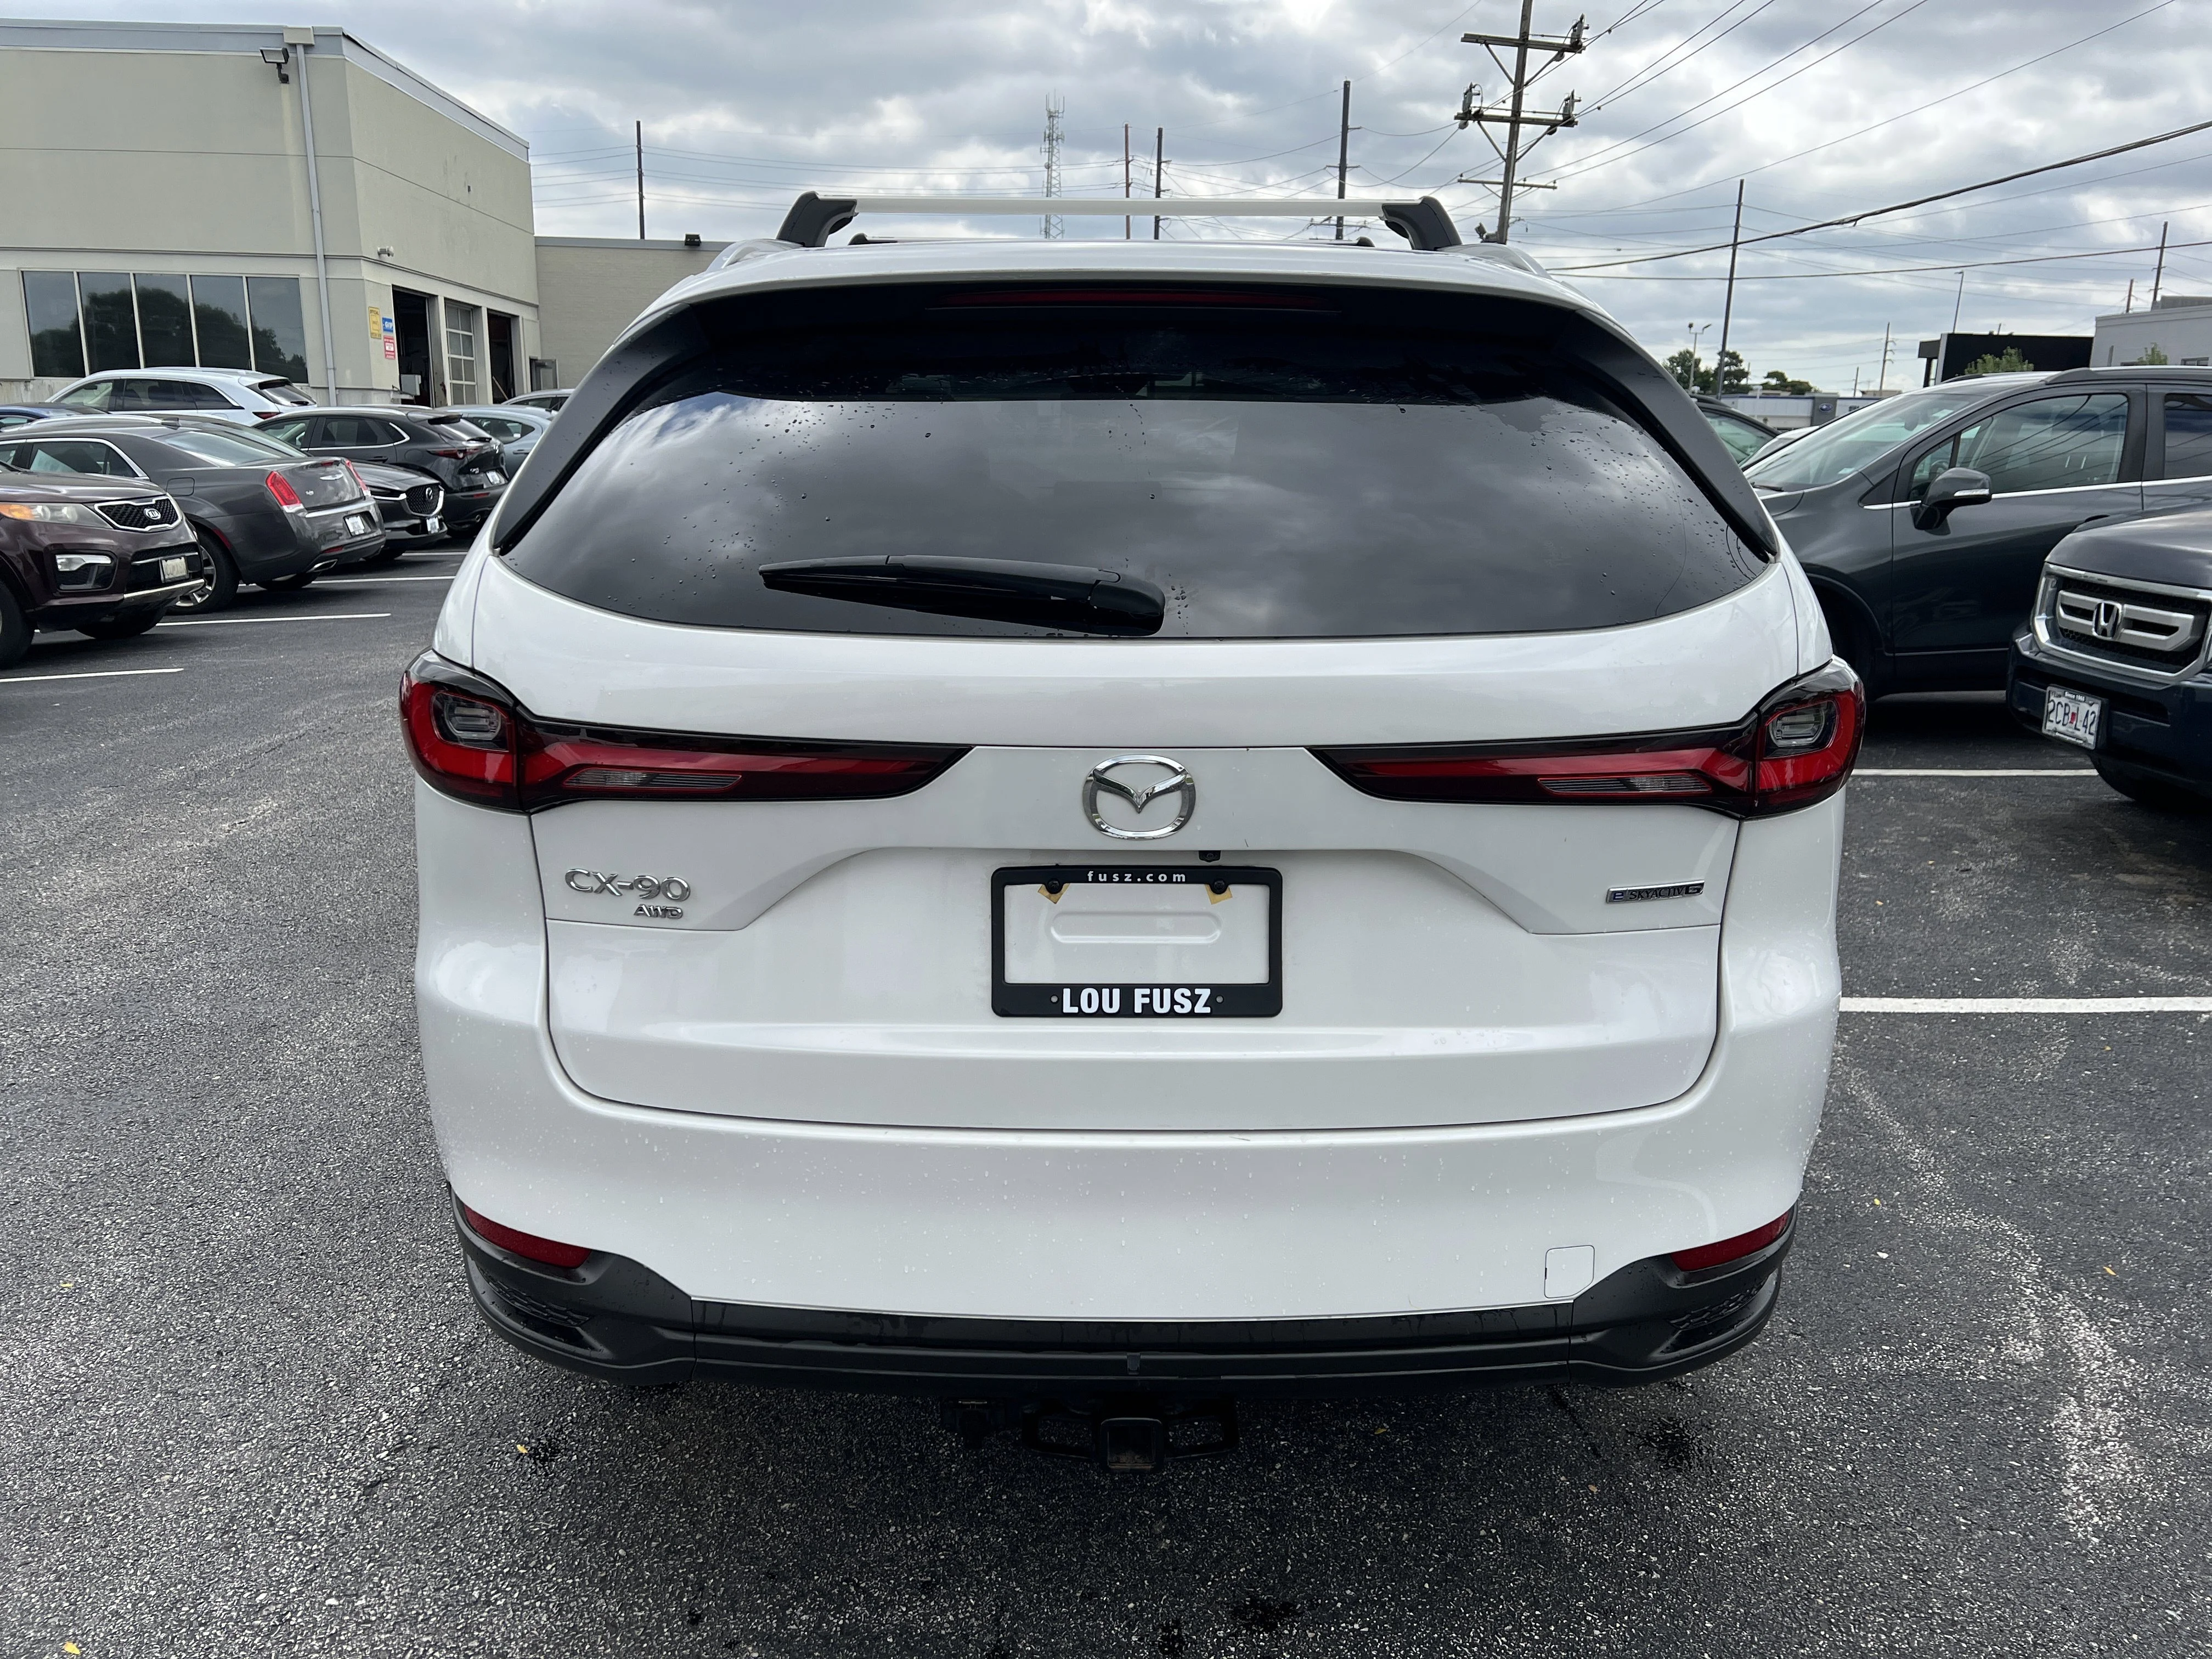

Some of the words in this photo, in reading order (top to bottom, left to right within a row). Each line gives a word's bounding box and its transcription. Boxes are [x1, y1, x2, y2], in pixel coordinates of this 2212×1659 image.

[2047, 699, 2070, 726] 2CB
[565, 868, 691, 902] CX-90
[1087, 871, 1186, 882] fusz.com
[634, 904, 684, 919] AWD
[1063, 988, 1120, 1014] LOU
[1134, 988, 1211, 1014] FUSZ
